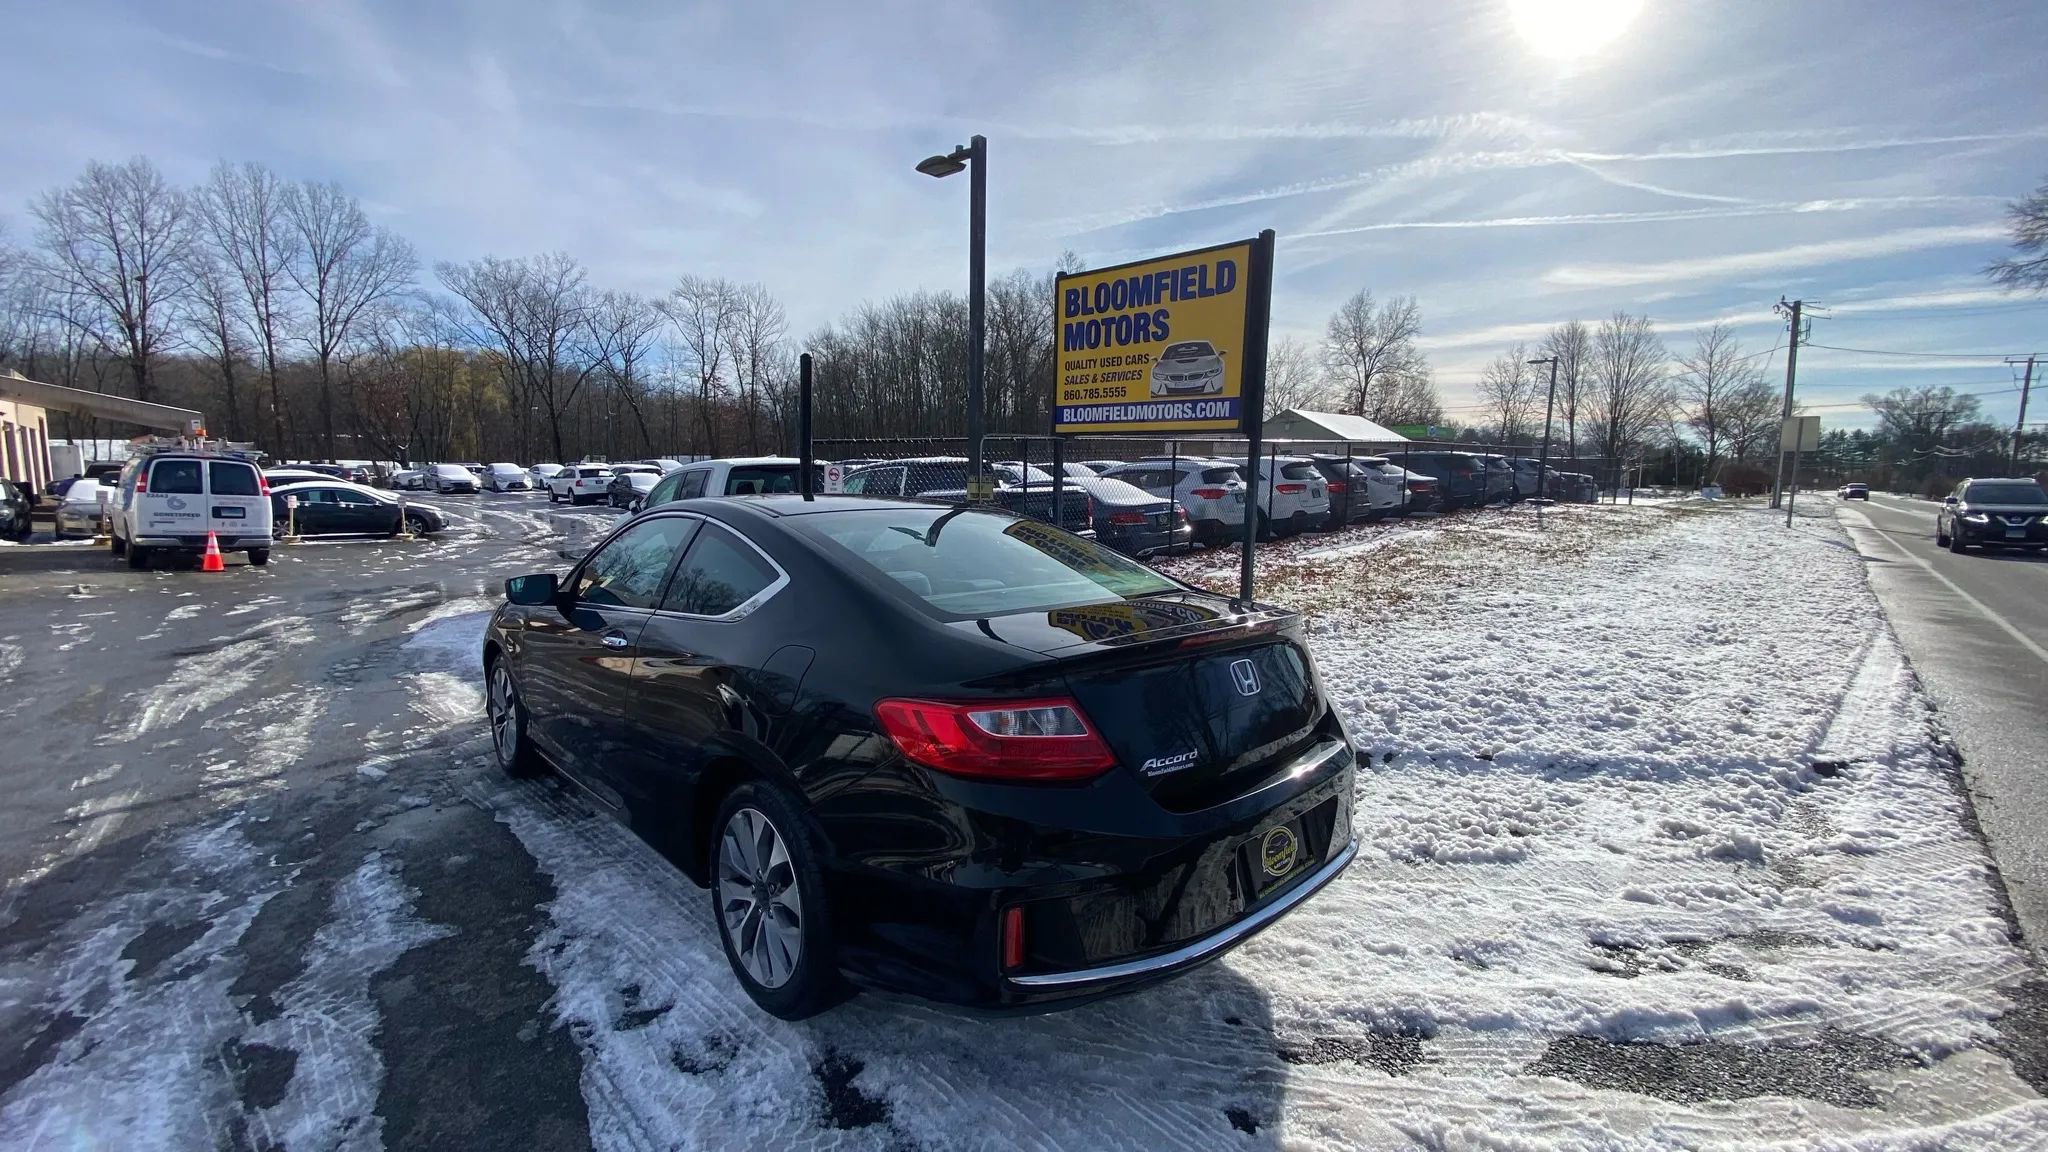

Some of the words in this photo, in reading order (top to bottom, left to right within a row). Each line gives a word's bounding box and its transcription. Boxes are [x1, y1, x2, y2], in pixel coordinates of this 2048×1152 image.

[1065, 260, 1236, 318] BLOOMFIELD
[1064, 309, 1170, 352] MOTORS
[1065, 358, 1097, 371] QUALITY
[1100, 356, 1122, 368] USED
[1125, 353, 1150, 366] CARS
[1064, 373, 1089, 386] SALES
[1091, 373, 1098, 383] &
[1100, 370, 1143, 382] SERVICES
[1064, 386, 1127, 401] 860.785.5555
[1063, 401, 1230, 422] BLOOMFIELDMOTORS.COM
[1140, 748, 1198, 772] Accord
